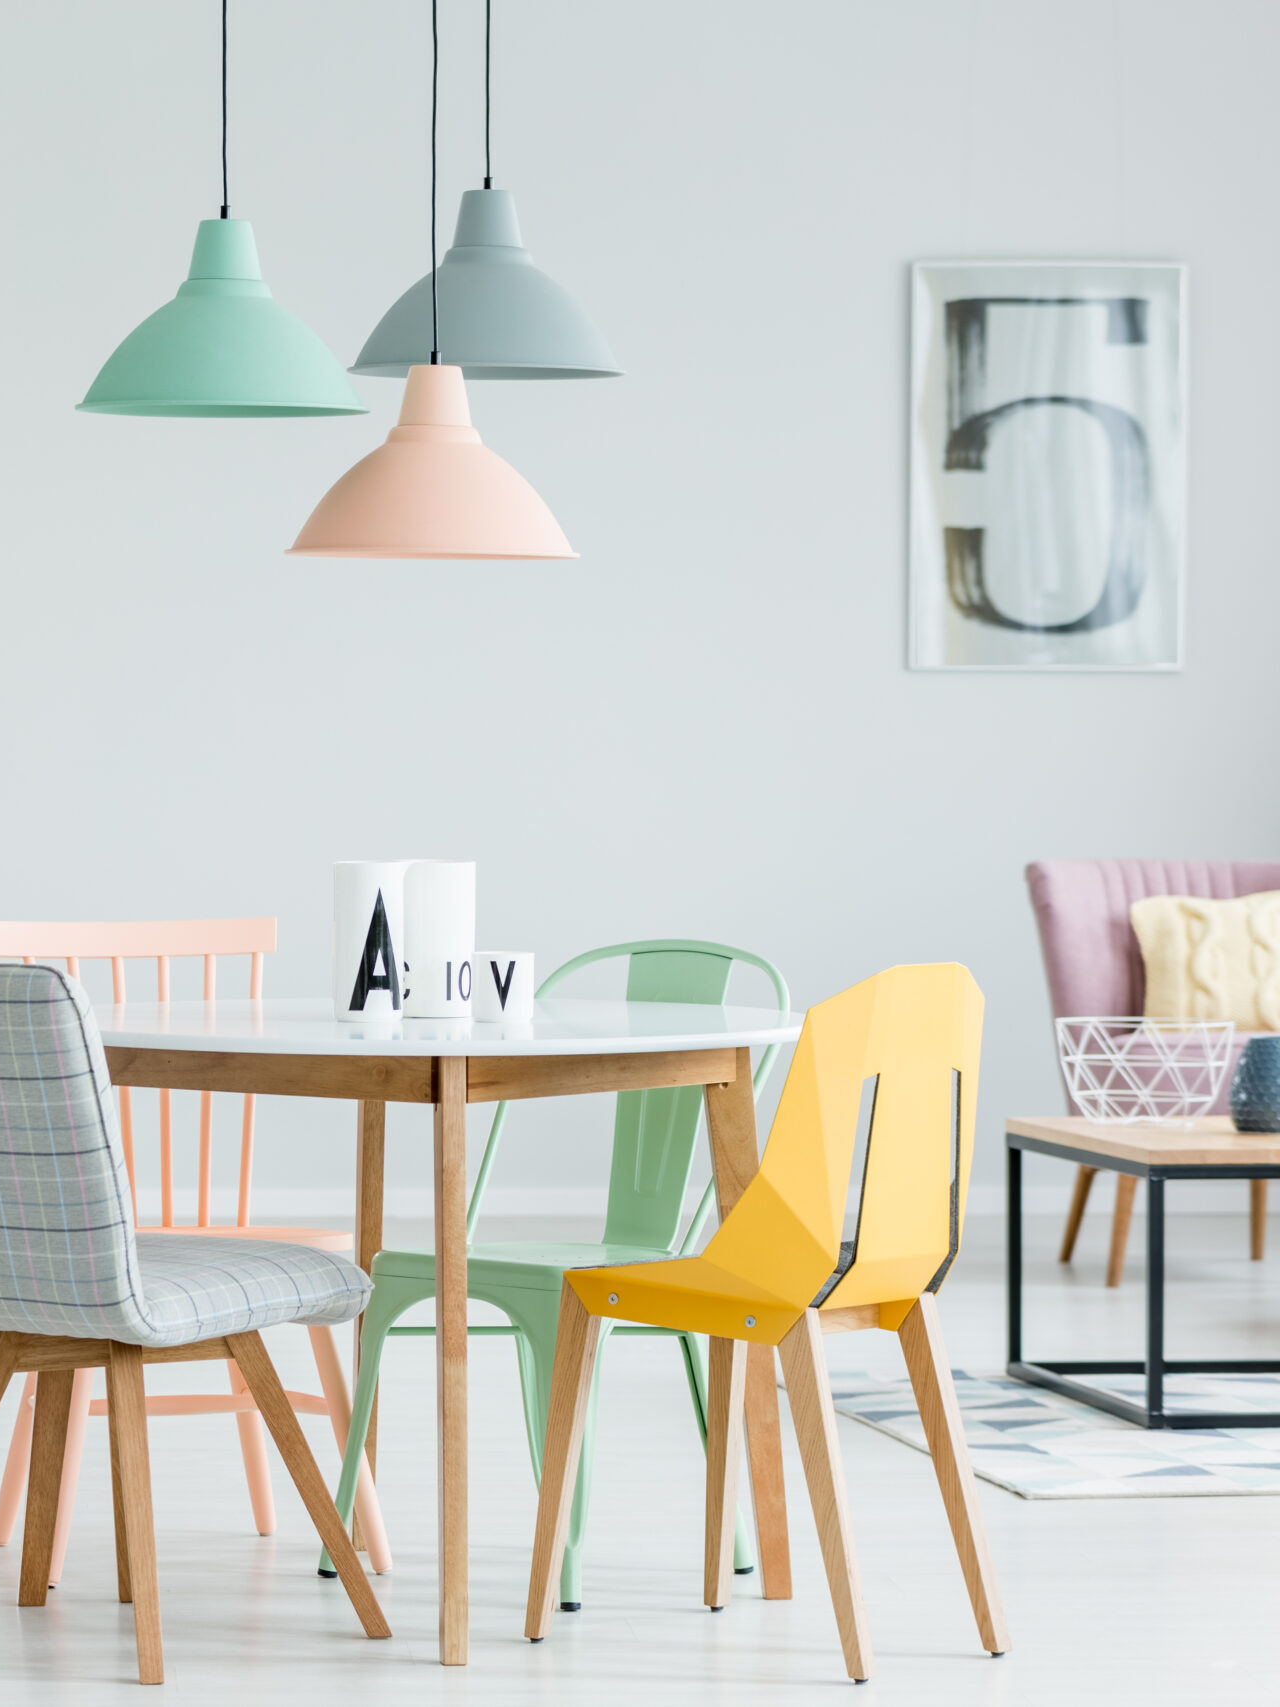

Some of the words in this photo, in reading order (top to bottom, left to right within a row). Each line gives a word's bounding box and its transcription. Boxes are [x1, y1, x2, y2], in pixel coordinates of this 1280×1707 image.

[944, 297, 1151, 635] 5
[348, 887, 402, 1012] A
[489, 960, 516, 1012] V
